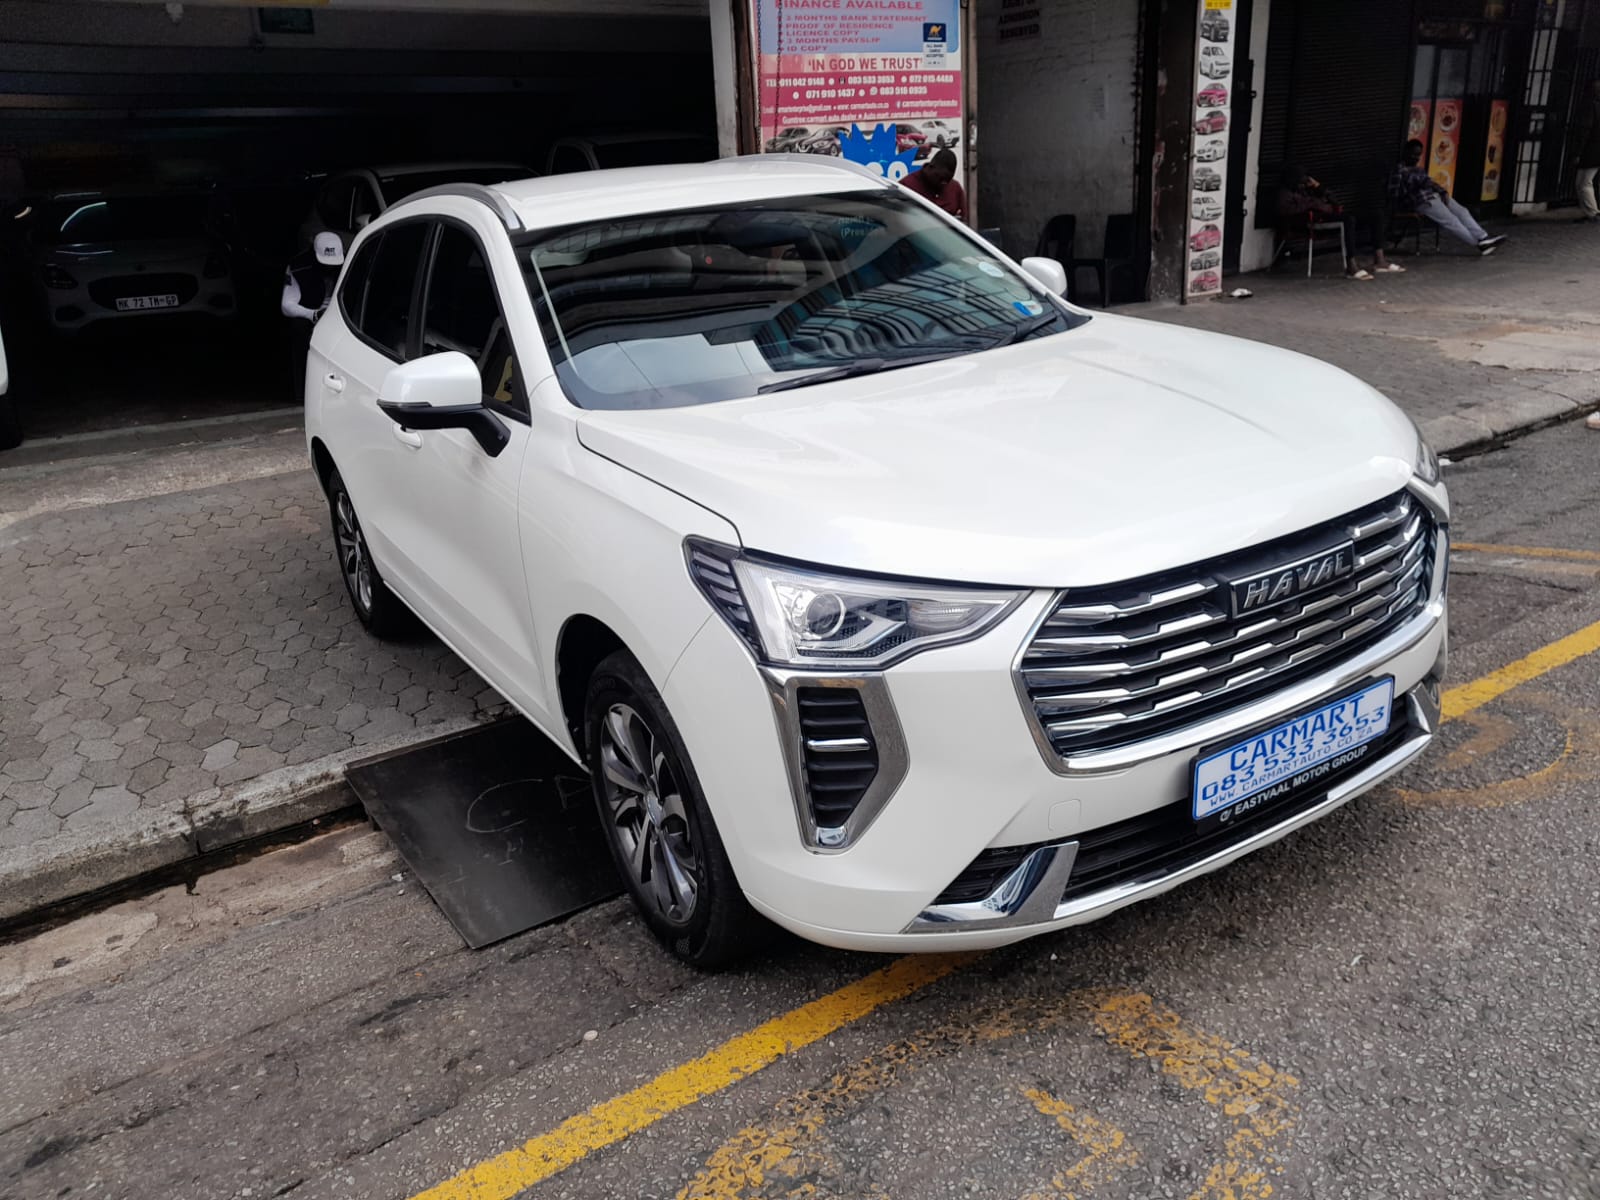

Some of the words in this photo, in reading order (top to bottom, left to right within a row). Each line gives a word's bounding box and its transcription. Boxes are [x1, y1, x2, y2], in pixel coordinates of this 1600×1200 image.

[775, 0, 841, 9] FINANCE
[846, 0, 924, 10] AVAILABLE
[829, 58, 855, 70] GOD
[860, 57, 877, 70] WE
[132, 298, 145, 307] 72
[165, 295, 177, 305] GP
[1243, 551, 1352, 608] HAVAL
[1202, 764, 1255, 801] 083
[1264, 738, 1314, 772] 533
[1322, 706, 1385, 745] 3653
[1230, 695, 1365, 771] CARMART
[1234, 783, 1290, 815] EASTVAAL
[1293, 762, 1331, 788] MOTOR
[1332, 744, 1368, 769] GROUP
